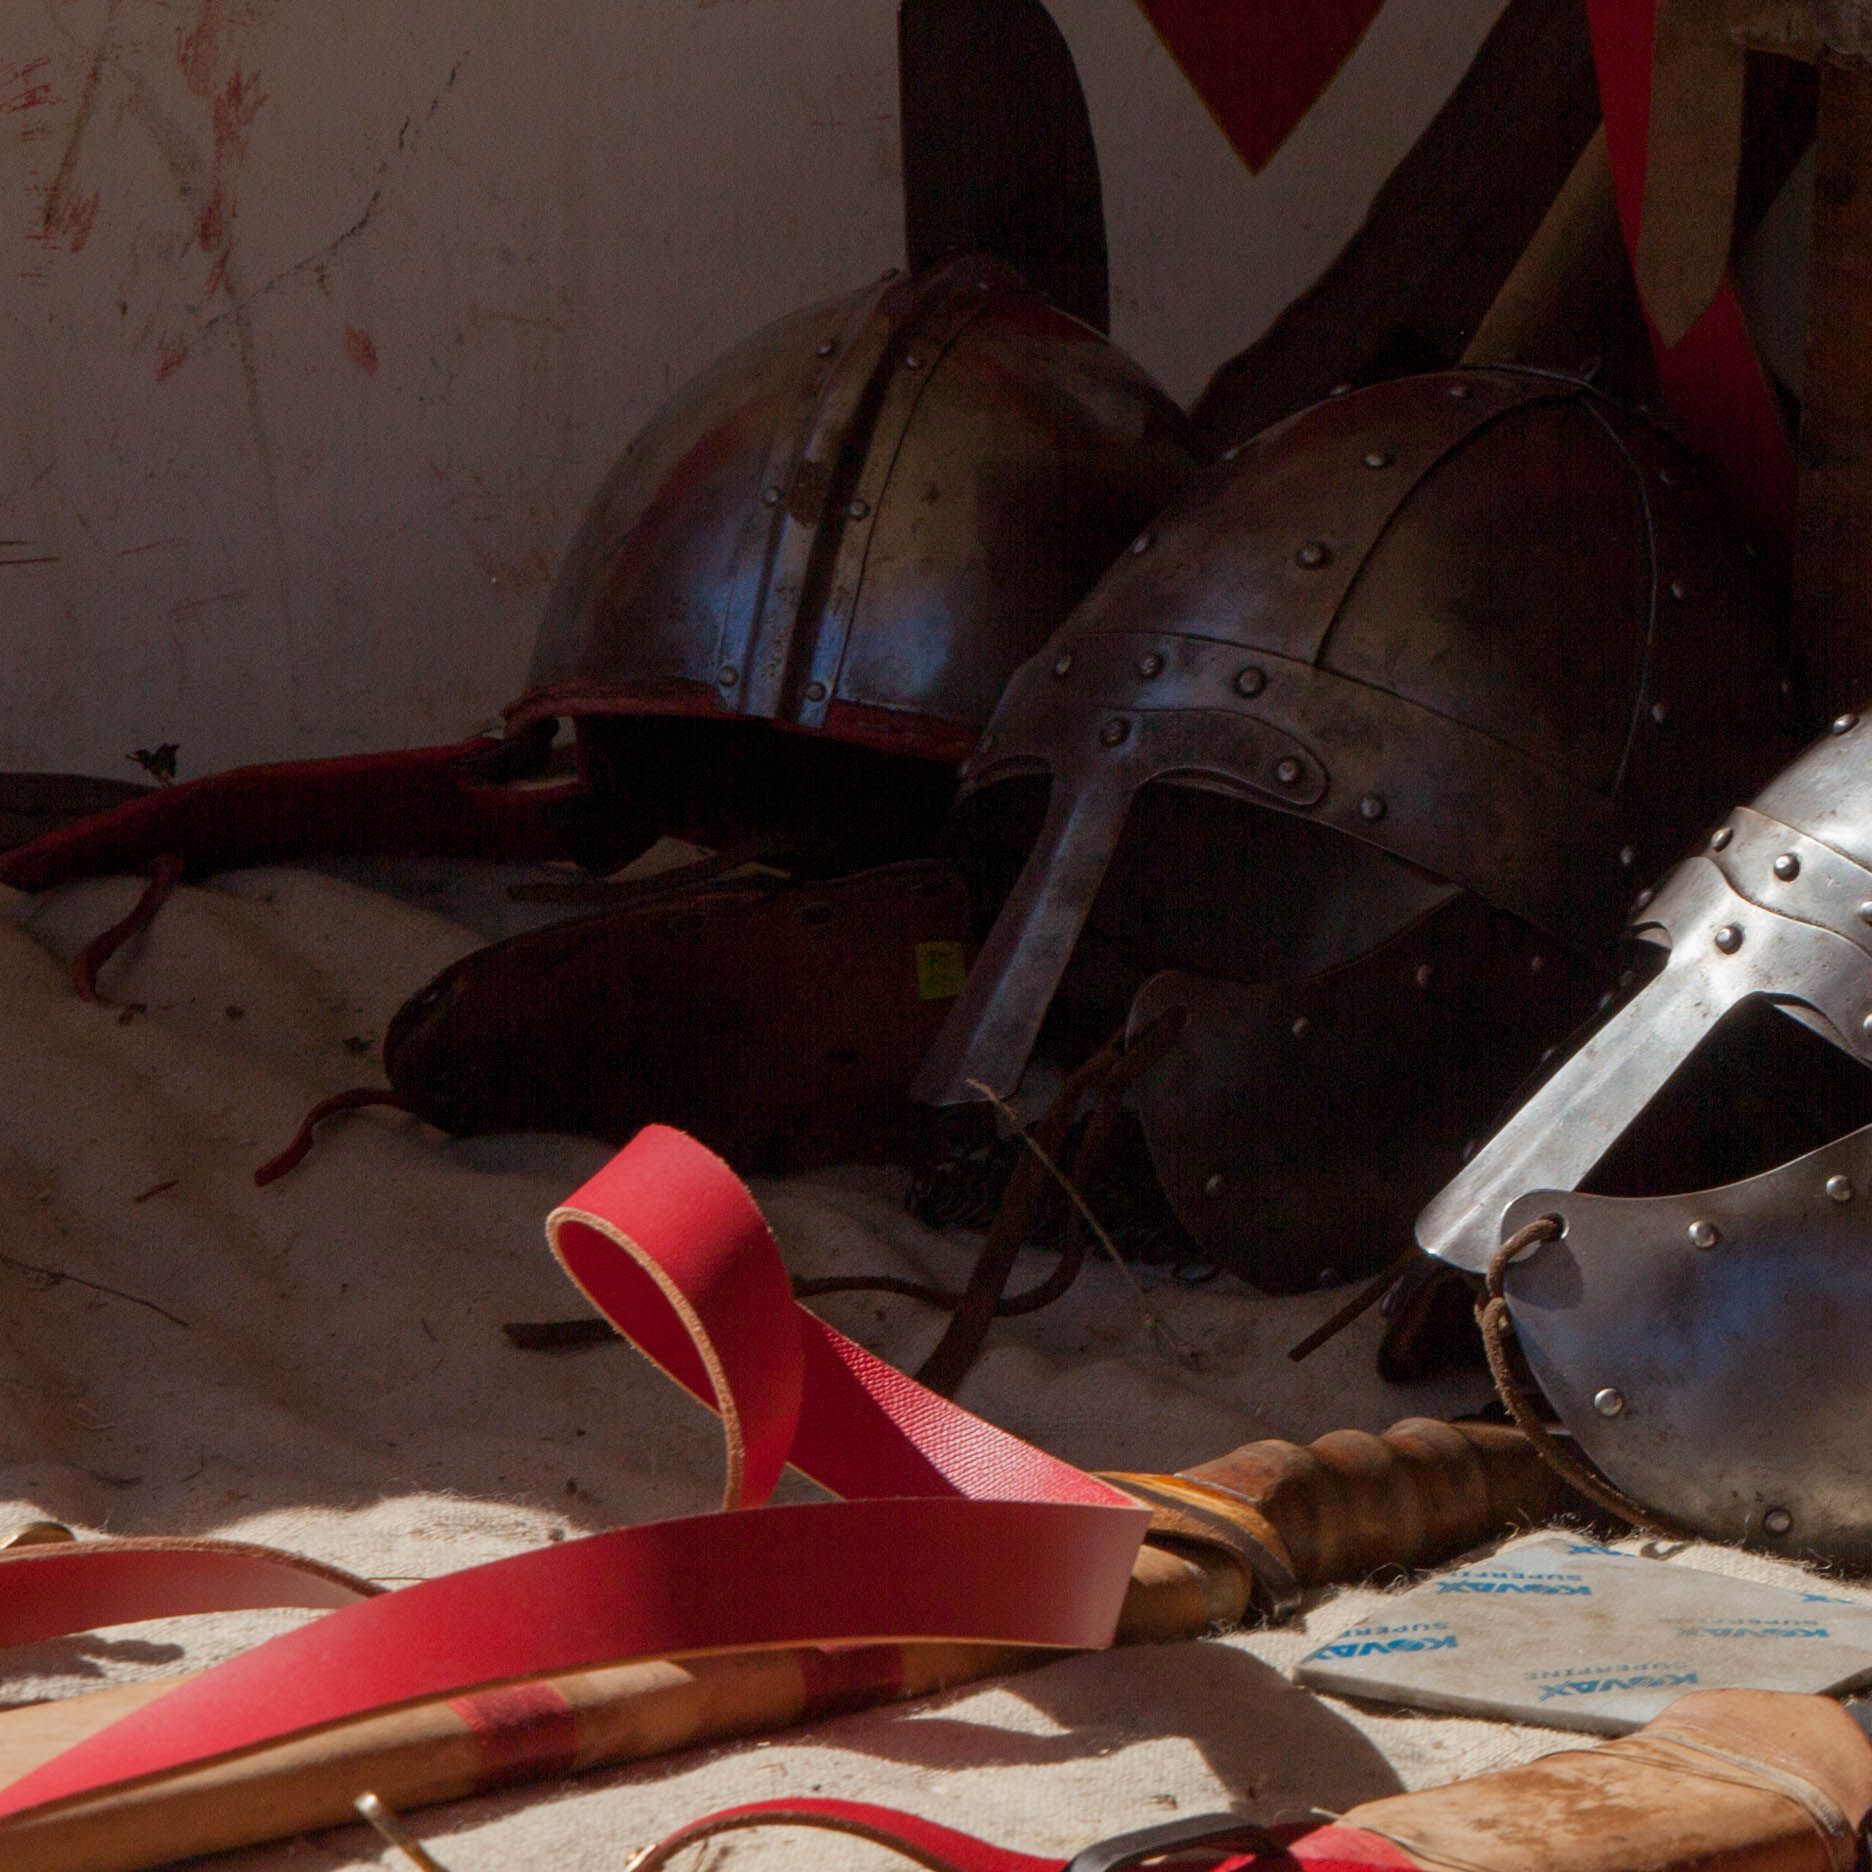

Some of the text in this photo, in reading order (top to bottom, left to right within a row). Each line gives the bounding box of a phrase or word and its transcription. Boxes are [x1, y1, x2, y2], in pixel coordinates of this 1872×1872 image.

[1436, 1581, 1592, 1596] KOVAX
[1523, 1663, 1689, 1680] SUPERFINE
[1538, 1672, 1698, 1701] KOVAX
